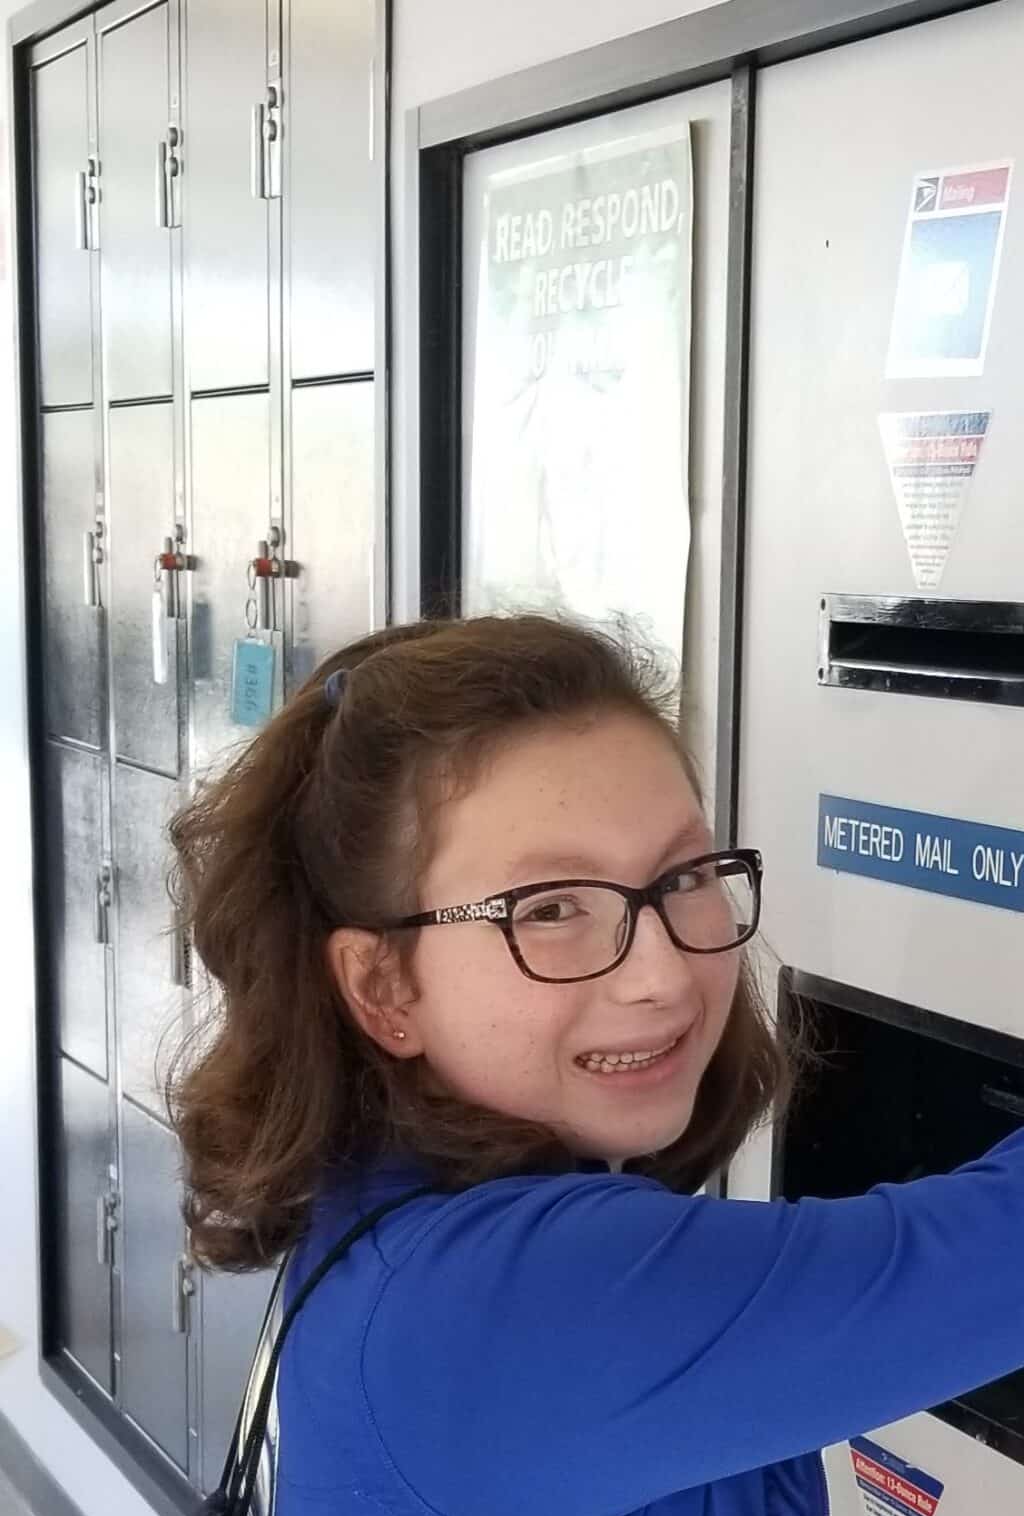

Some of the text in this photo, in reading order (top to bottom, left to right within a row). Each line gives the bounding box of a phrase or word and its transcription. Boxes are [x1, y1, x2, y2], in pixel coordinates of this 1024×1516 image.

[824, 815, 1024, 887] METERED MAIL ONLY
